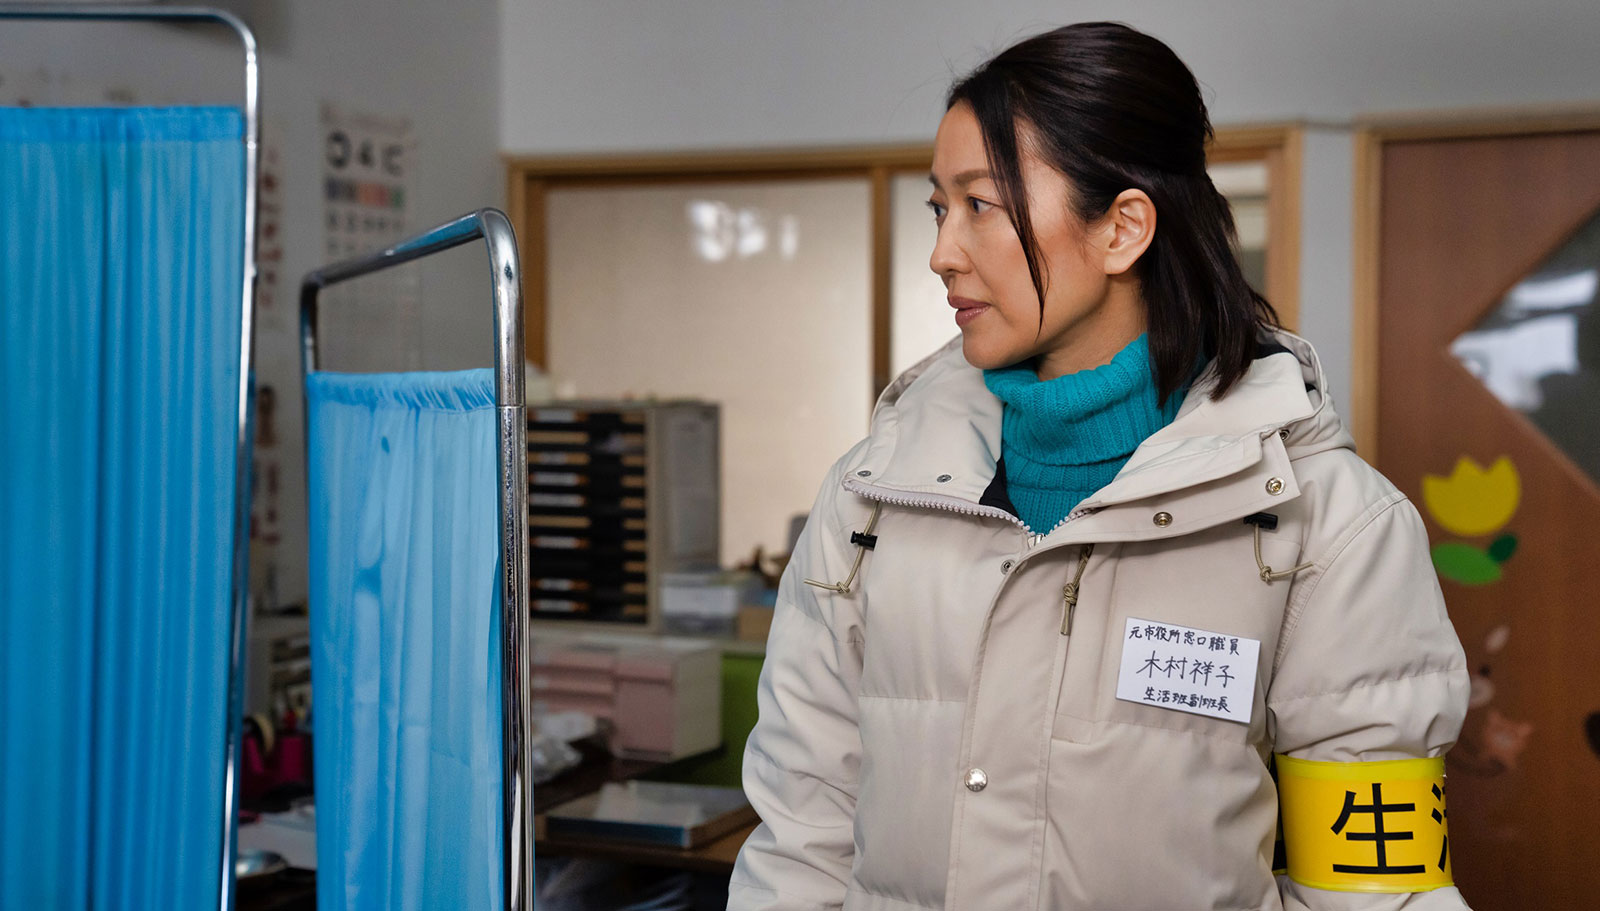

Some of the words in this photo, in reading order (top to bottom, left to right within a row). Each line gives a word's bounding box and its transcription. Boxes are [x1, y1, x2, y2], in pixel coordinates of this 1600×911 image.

[1136, 650, 1235, 688] 木村祥子
[1143, 686, 1231, 713] 生活班副班長
